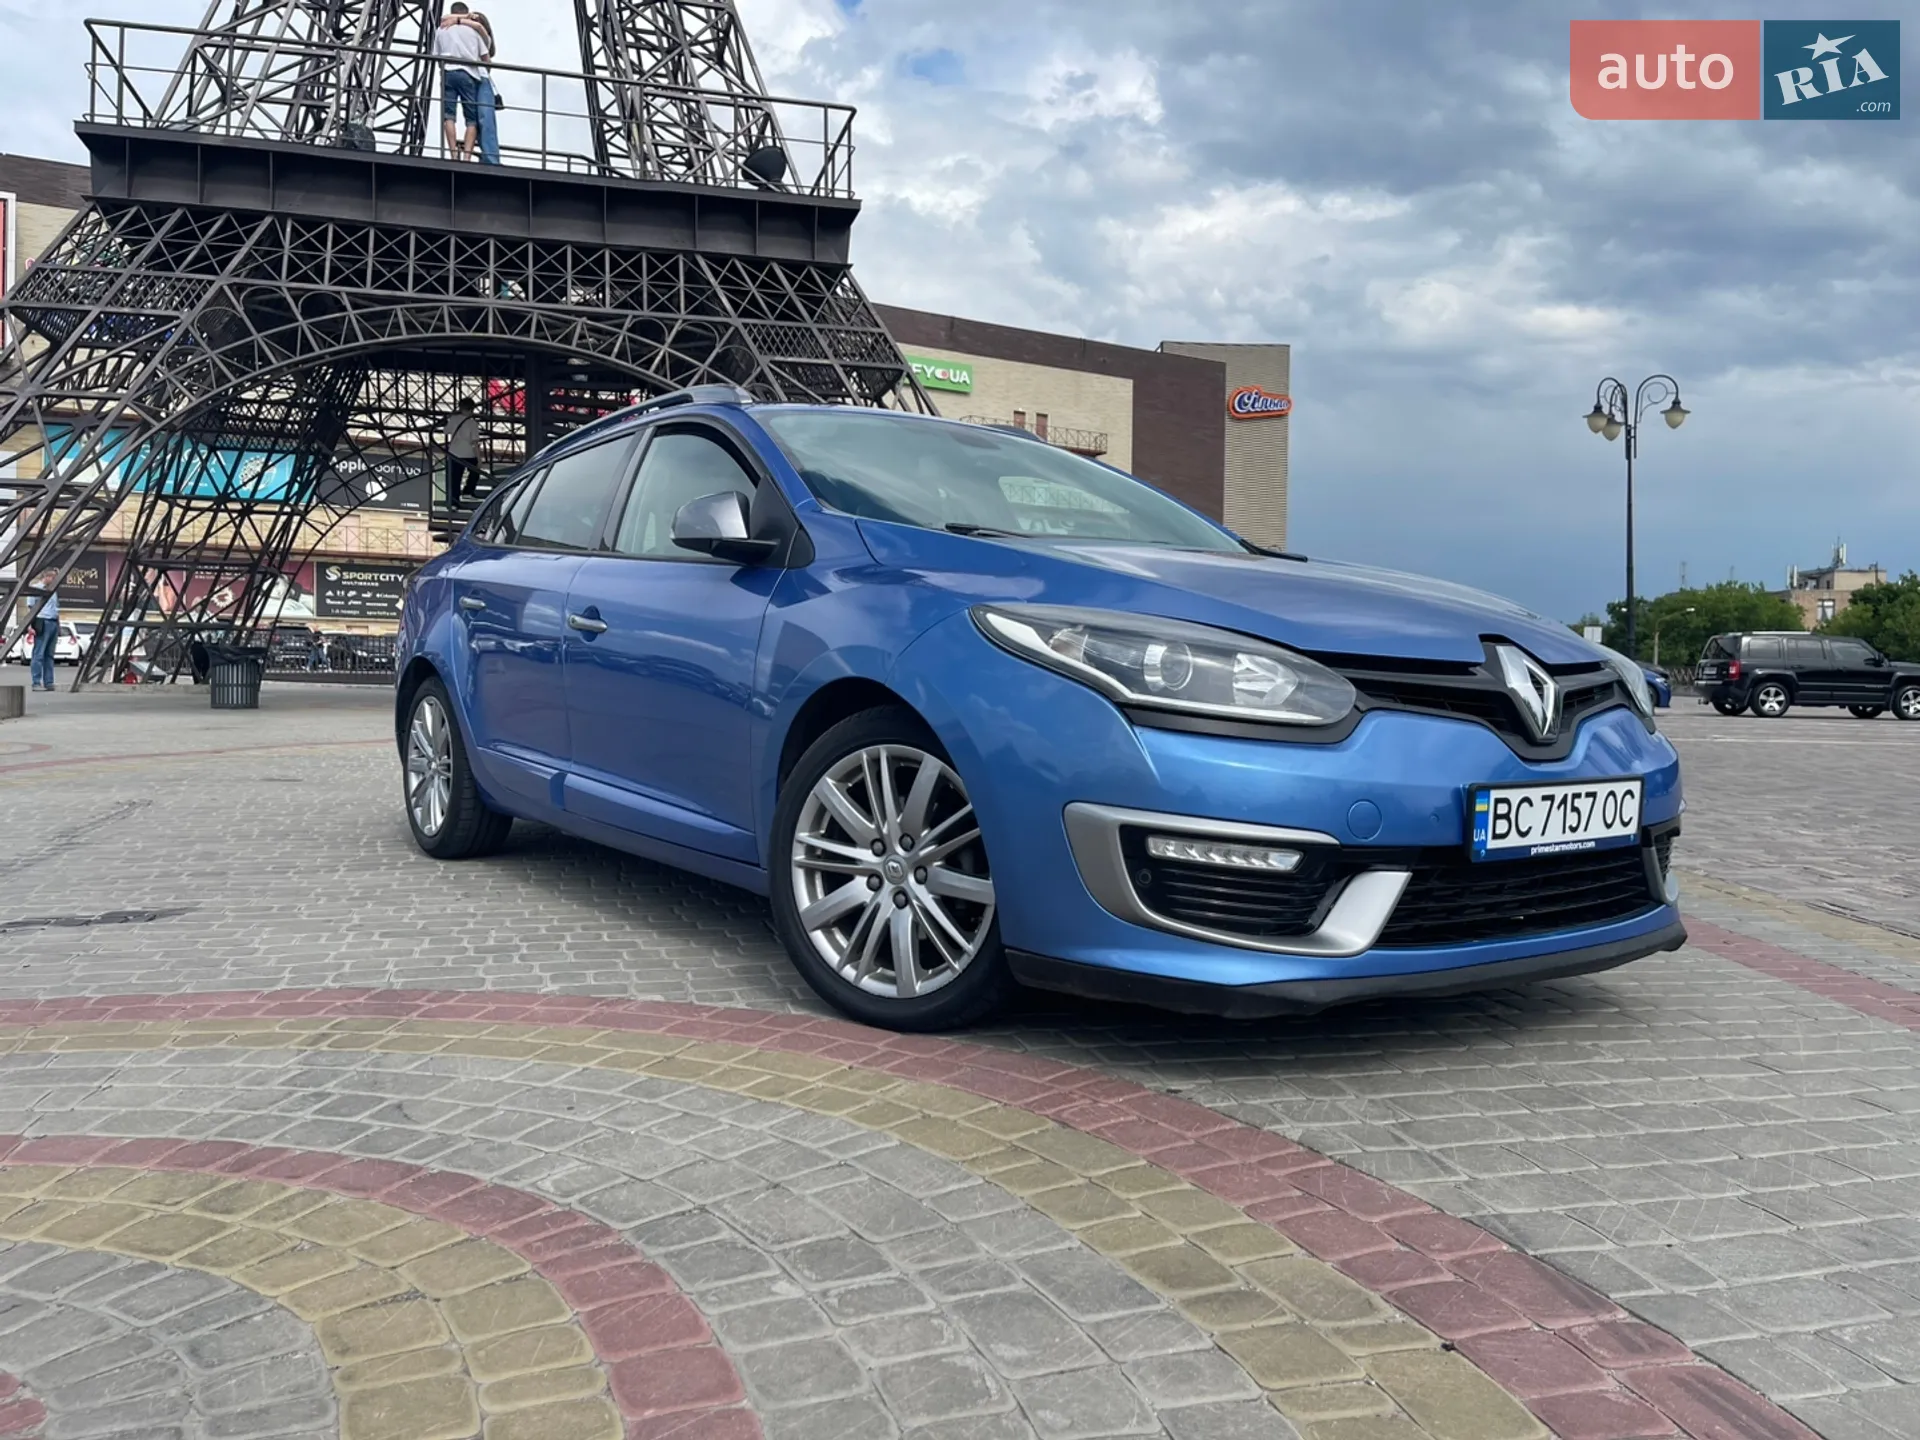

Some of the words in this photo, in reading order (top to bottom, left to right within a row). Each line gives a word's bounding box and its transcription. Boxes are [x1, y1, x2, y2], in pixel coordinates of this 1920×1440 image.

[342, 571, 404, 582] SPORTCITY
[1491, 795, 1534, 841] BC
[1540, 791, 1598, 838] 7157
[1602, 789, 1635, 830] OC
[1473, 828, 1486, 842] UA
[1530, 839, 1596, 856] primestarmotors.com
